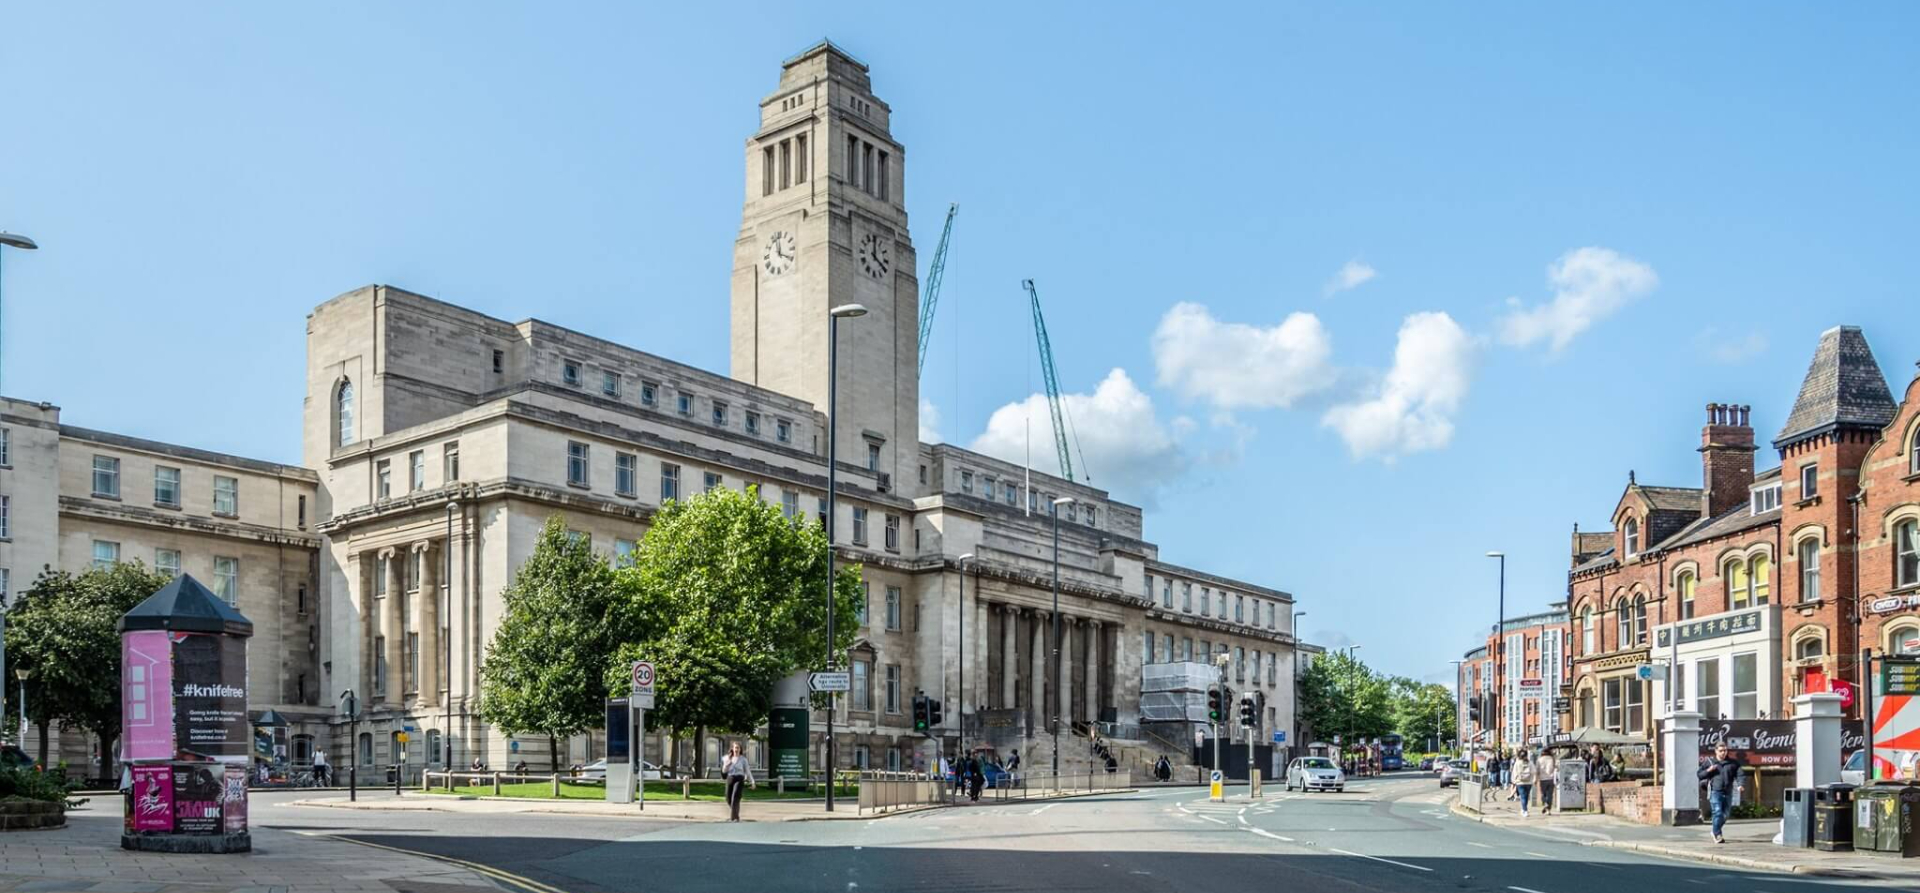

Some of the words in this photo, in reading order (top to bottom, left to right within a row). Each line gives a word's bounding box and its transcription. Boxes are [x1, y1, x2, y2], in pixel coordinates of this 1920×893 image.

[637, 670, 651, 680] 20
[183, 684, 243, 698] #knifefree
[634, 685, 652, 693] ZONE
[204, 807, 220, 818] UK
